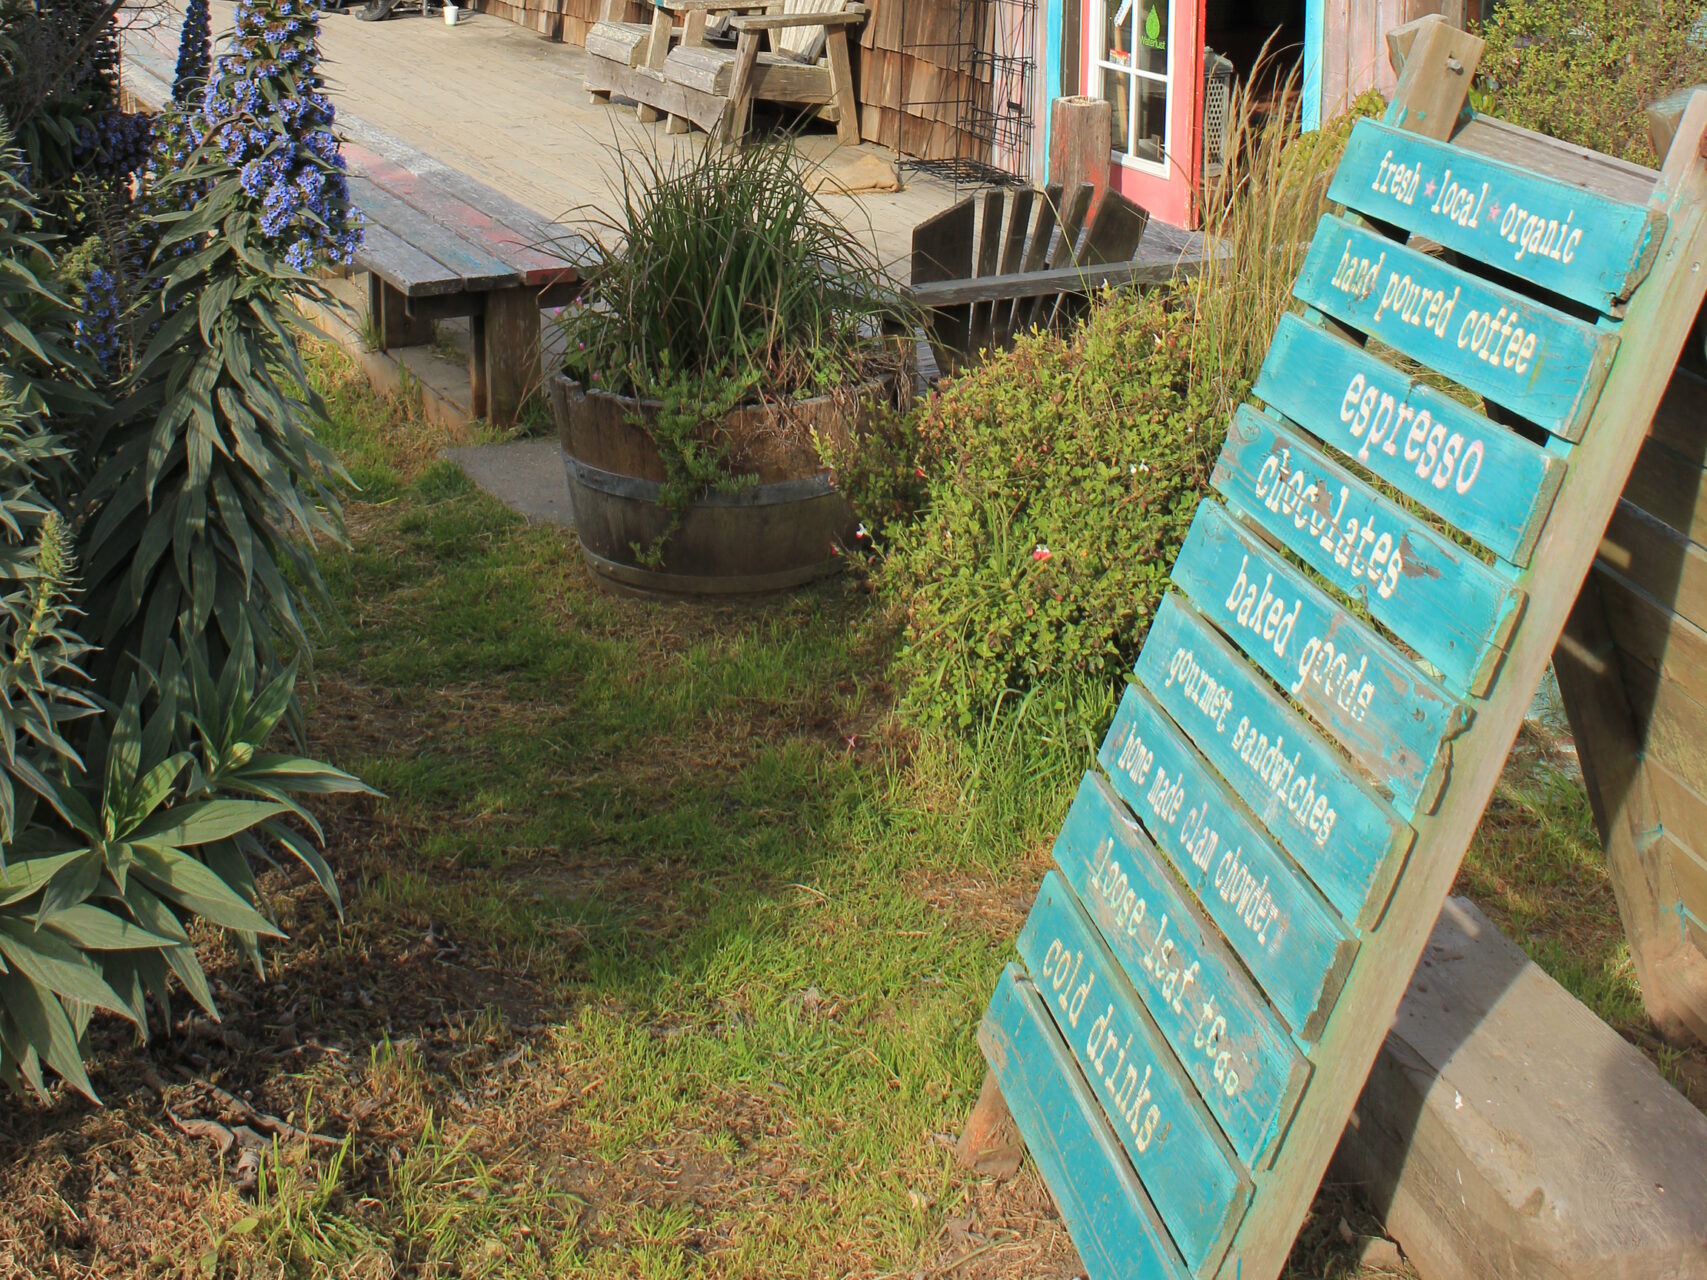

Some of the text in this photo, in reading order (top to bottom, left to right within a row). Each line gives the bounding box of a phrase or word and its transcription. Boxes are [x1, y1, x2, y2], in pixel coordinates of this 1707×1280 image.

[1140, 36, 1166, 49] Waterlust
[1371, 151, 1583, 264] fresh local organic
[1331, 239, 1537, 376] hand poured coffee
[1339, 372, 1484, 497] espresso
[1255, 448, 1403, 599] chocolates
[1225, 555, 1376, 722] baked goods
[1164, 647, 1337, 846] gourmet sandwiches
[1117, 721, 1279, 945] home made clam chowder
[1090, 836, 1146, 937] loose
[1144, 913, 1201, 1014] leaf
[1043, 937, 1161, 1153] cold drinks
